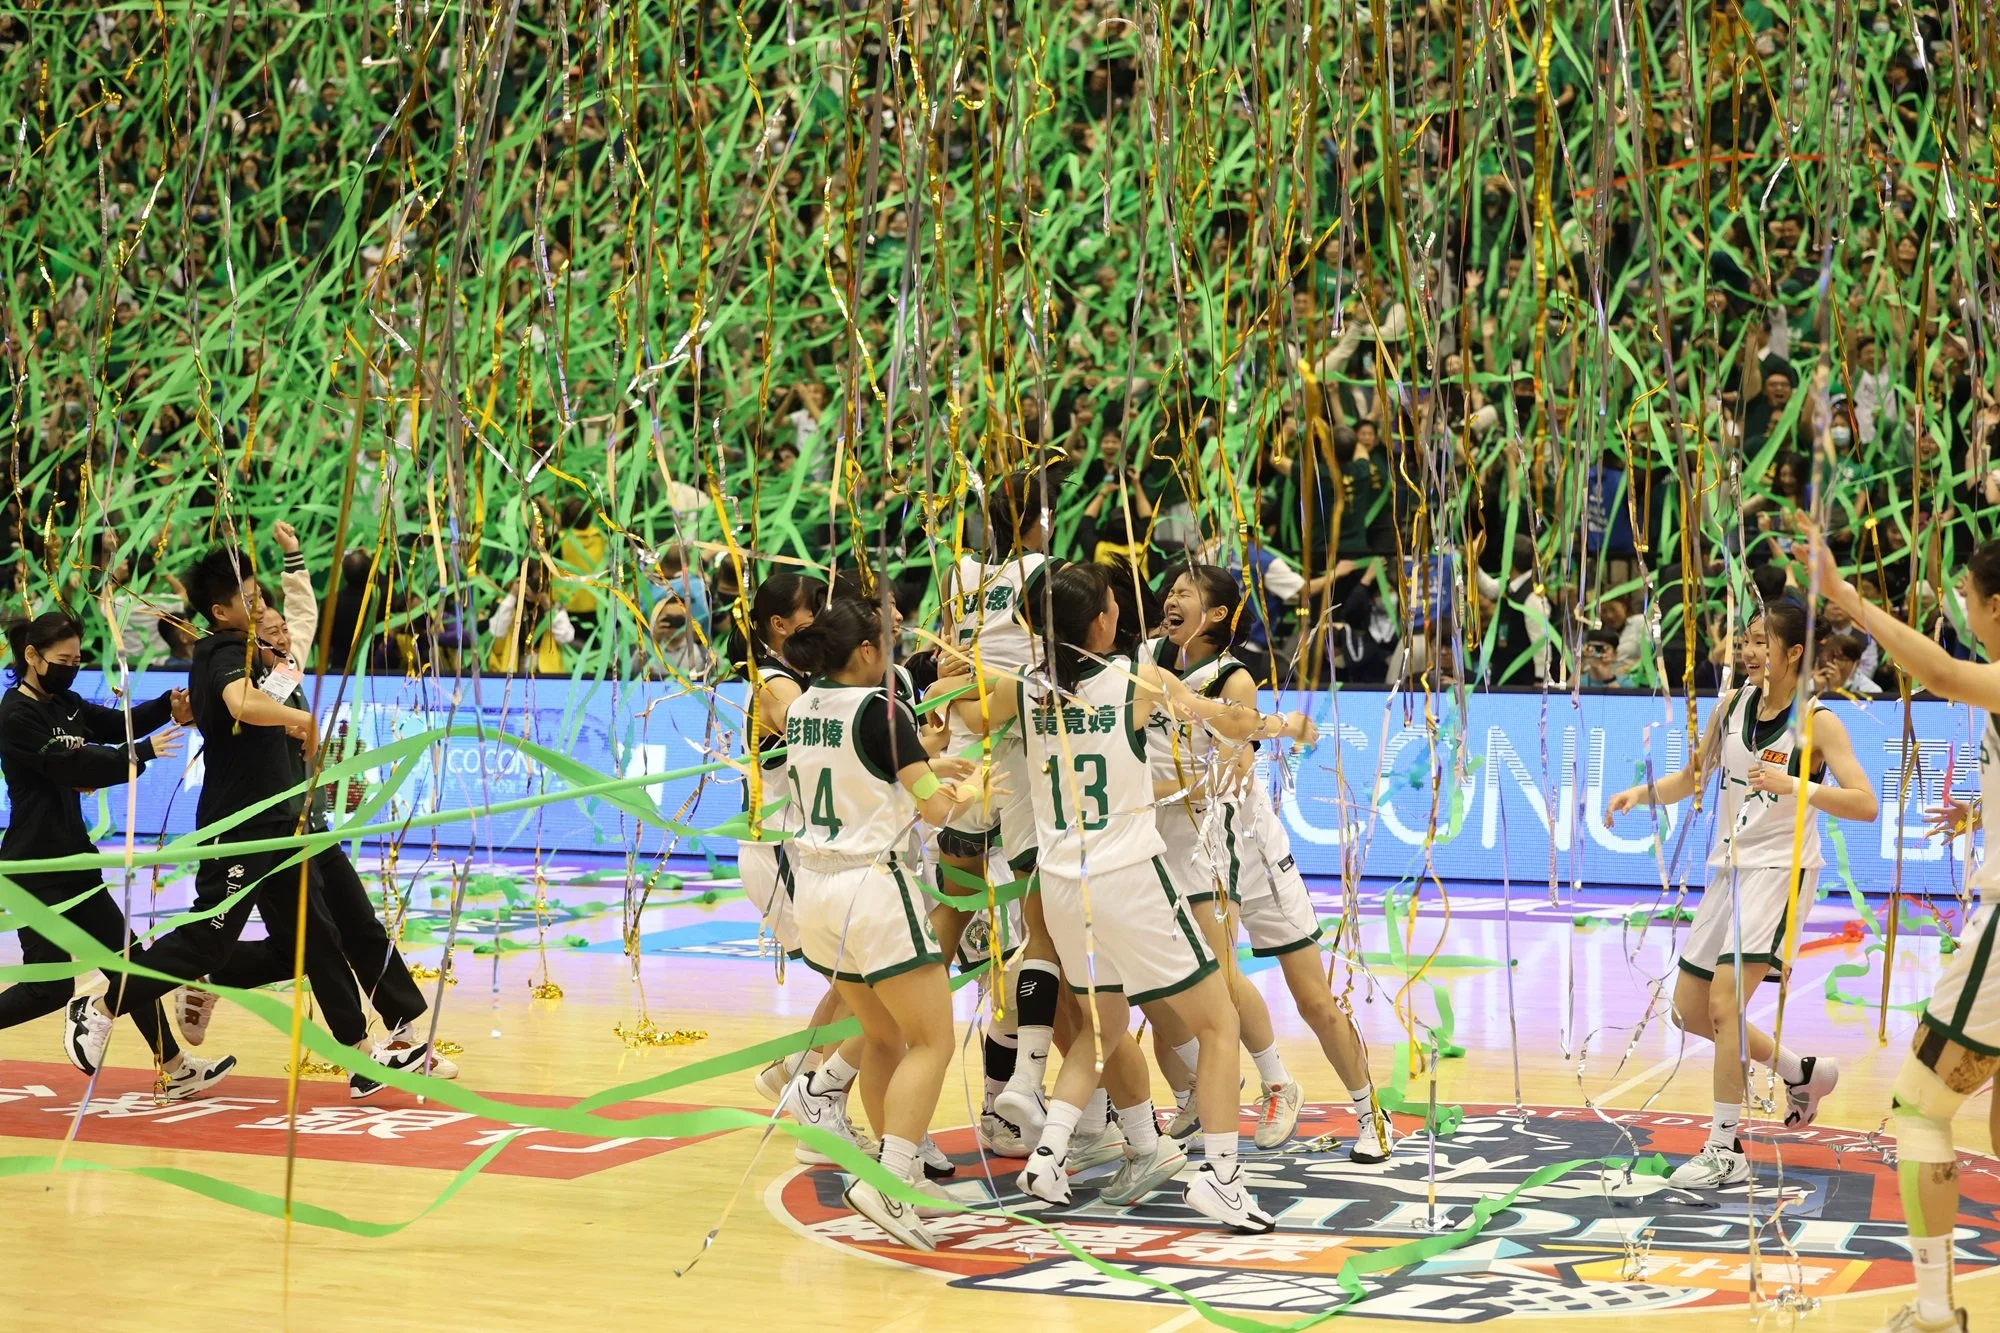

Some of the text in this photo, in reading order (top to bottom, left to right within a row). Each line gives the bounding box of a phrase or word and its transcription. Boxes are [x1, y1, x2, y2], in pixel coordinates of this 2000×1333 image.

[447, 747, 562, 777] COCONU
[1050, 754, 1109, 830] 13
[1281, 722, 1690, 854] CONU
[185, 985, 207, 1026] IR
[1496, 1107, 1582, 1119] OF
